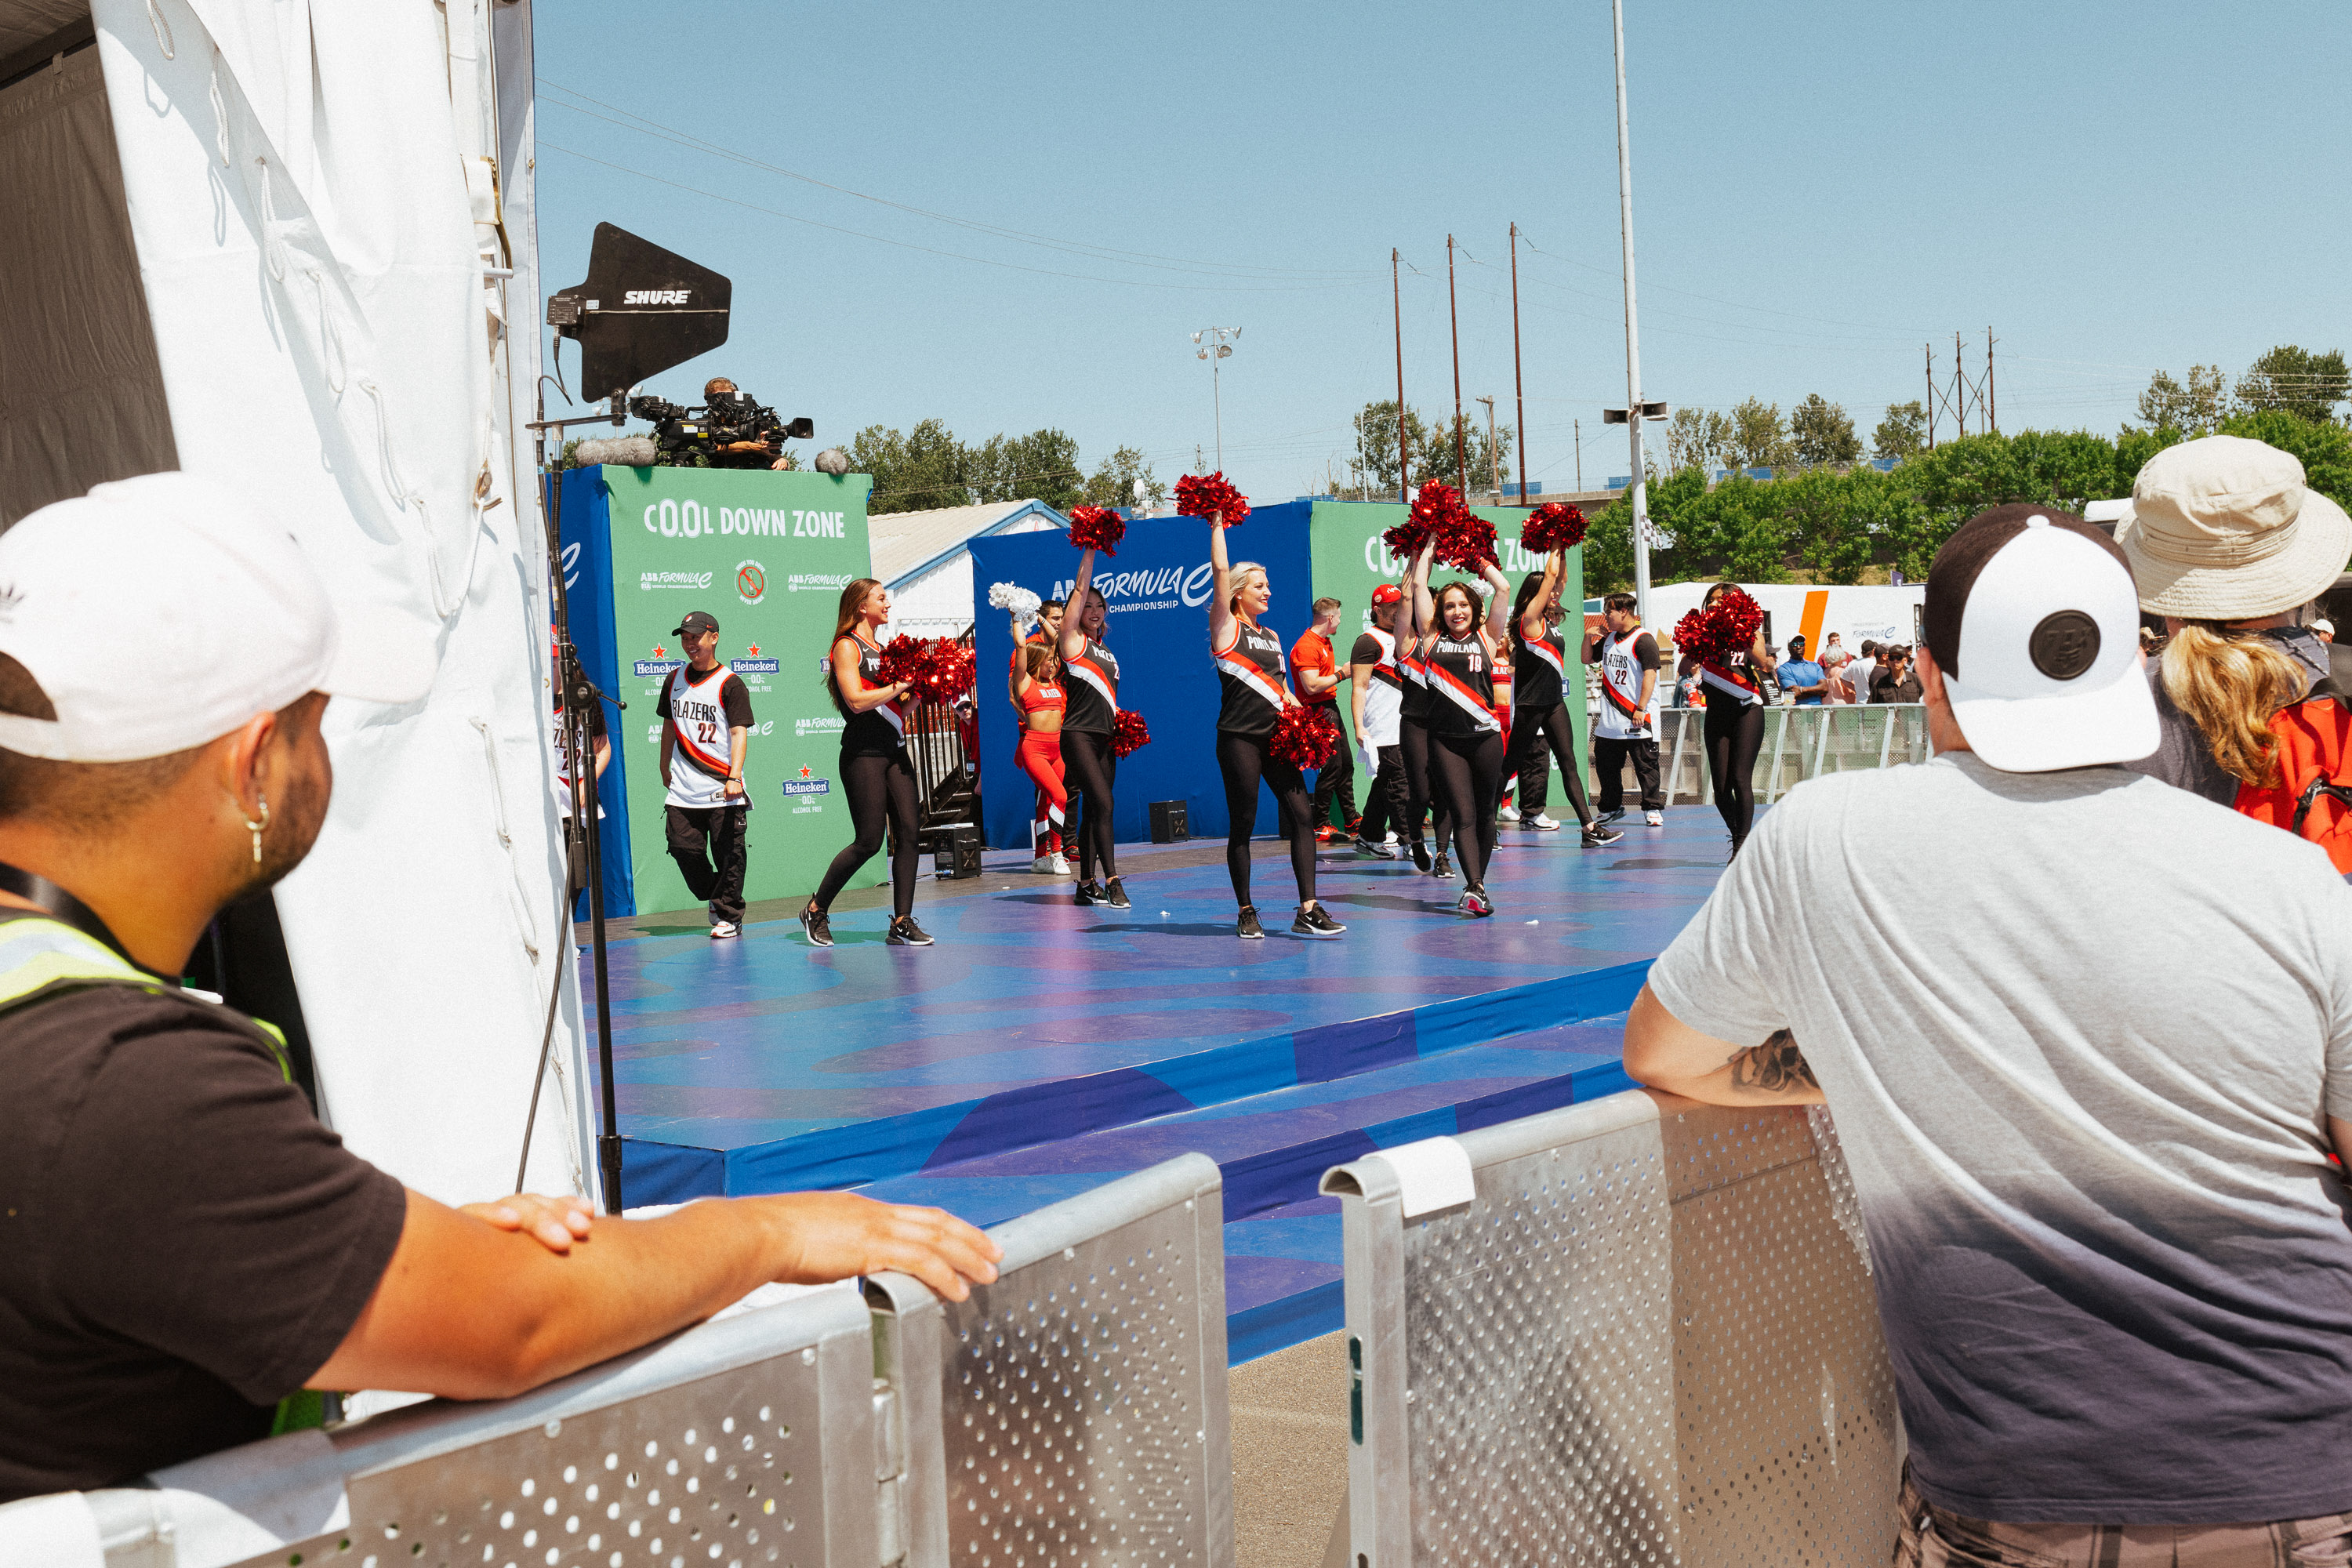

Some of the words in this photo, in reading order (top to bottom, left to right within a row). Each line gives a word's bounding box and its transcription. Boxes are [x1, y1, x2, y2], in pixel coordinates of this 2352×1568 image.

[624, 291, 688, 305] SHURE
[720, 507, 786, 536] DOWN
[792, 510, 845, 538] ZONE
[641, 572, 659, 582] ABB
[659, 572, 700, 583] FORMULA
[788, 575, 804, 584] ABB
[804, 574, 841, 585] FORMULA
[1093, 566, 1184, 599] FORMULA
[1109, 600, 1179, 613] CHAMPIONSHIP
[1436, 641, 1481, 655] PORTLAND
[1468, 654, 1483, 673] 19
[1730, 651, 1745, 666] 22
[636, 662, 682, 674] Heineke
[733, 661, 777, 672] Heineken
[1614, 669, 1628, 686] 22
[795, 719, 811, 728] ABB
[698, 722, 717, 745] 22
[785, 782, 827, 793] Heineken
